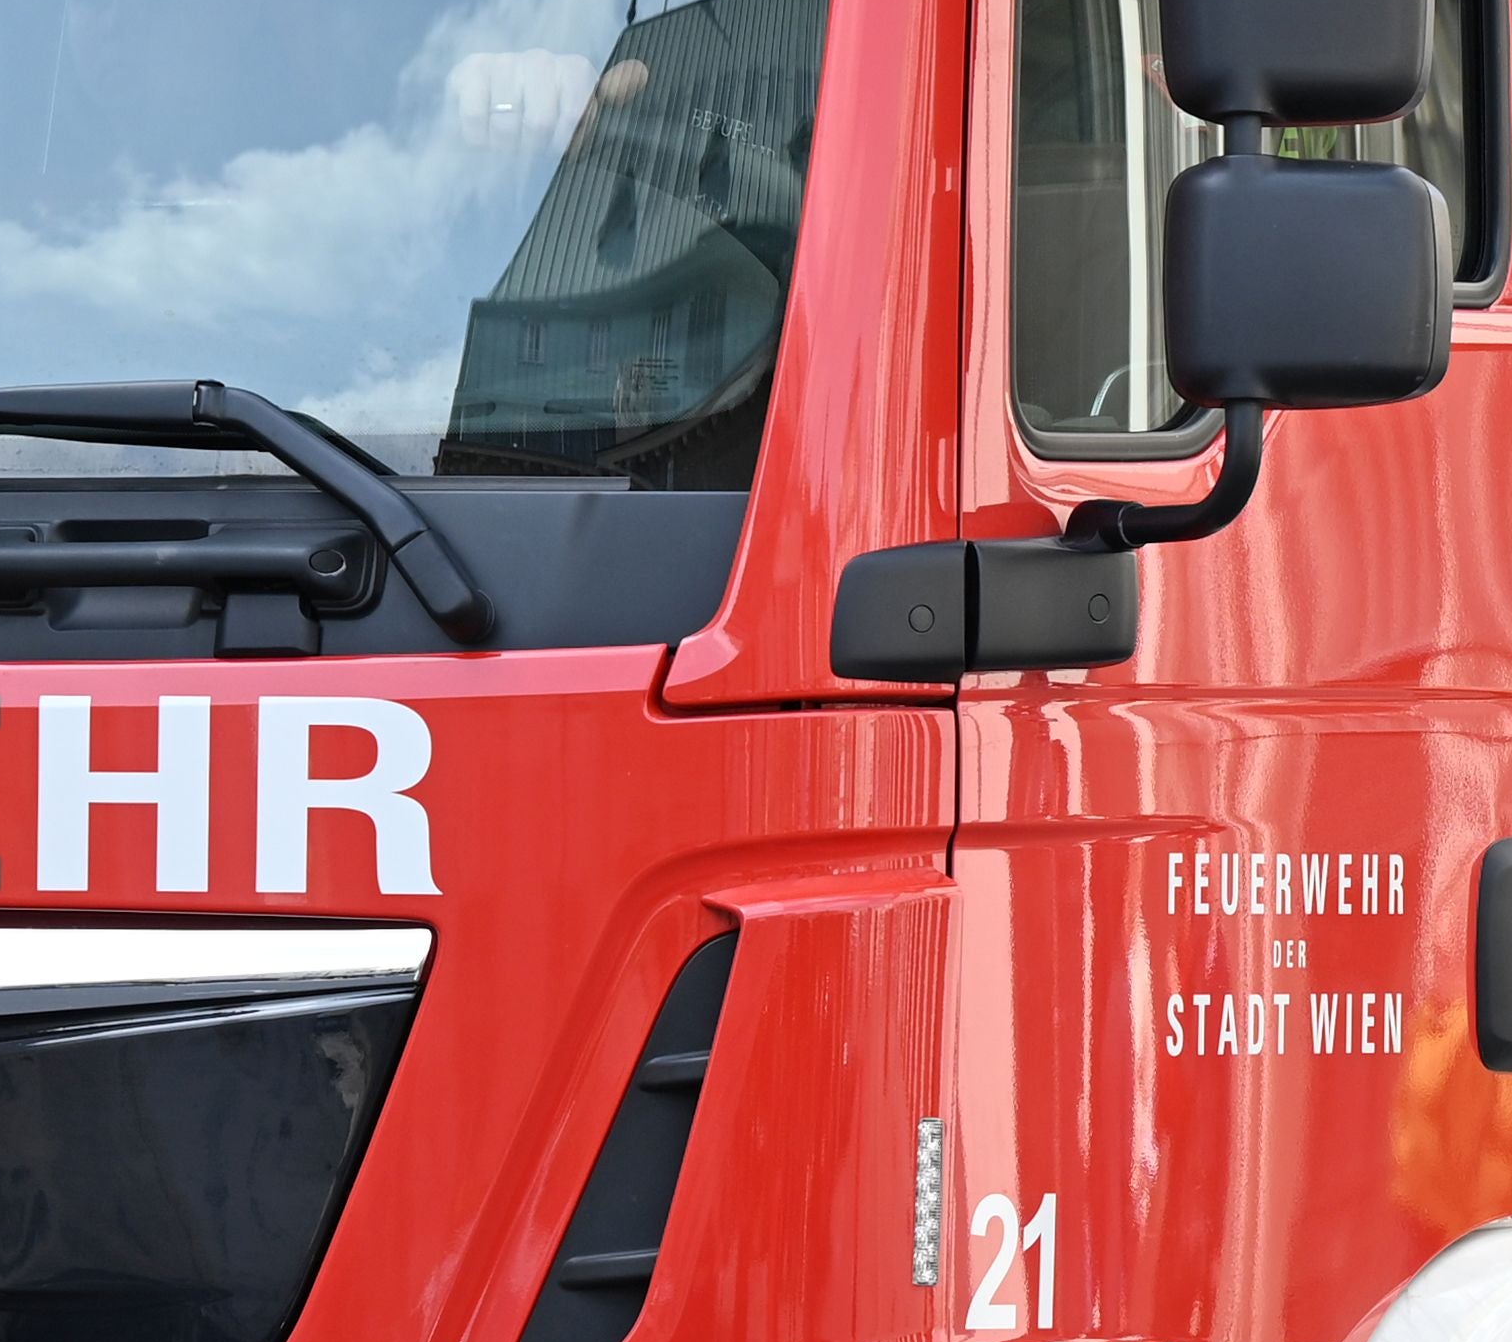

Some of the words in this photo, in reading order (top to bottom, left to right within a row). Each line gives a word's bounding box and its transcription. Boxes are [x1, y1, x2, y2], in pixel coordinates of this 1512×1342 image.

[1167, 851, 1407, 916] FEUERWEHR
[1273, 938, 1307, 969] DER
[1166, 993, 1289, 1057] STADT
[1310, 992, 1404, 1055] WIEN
[964, 1191, 1058, 1331] 21
